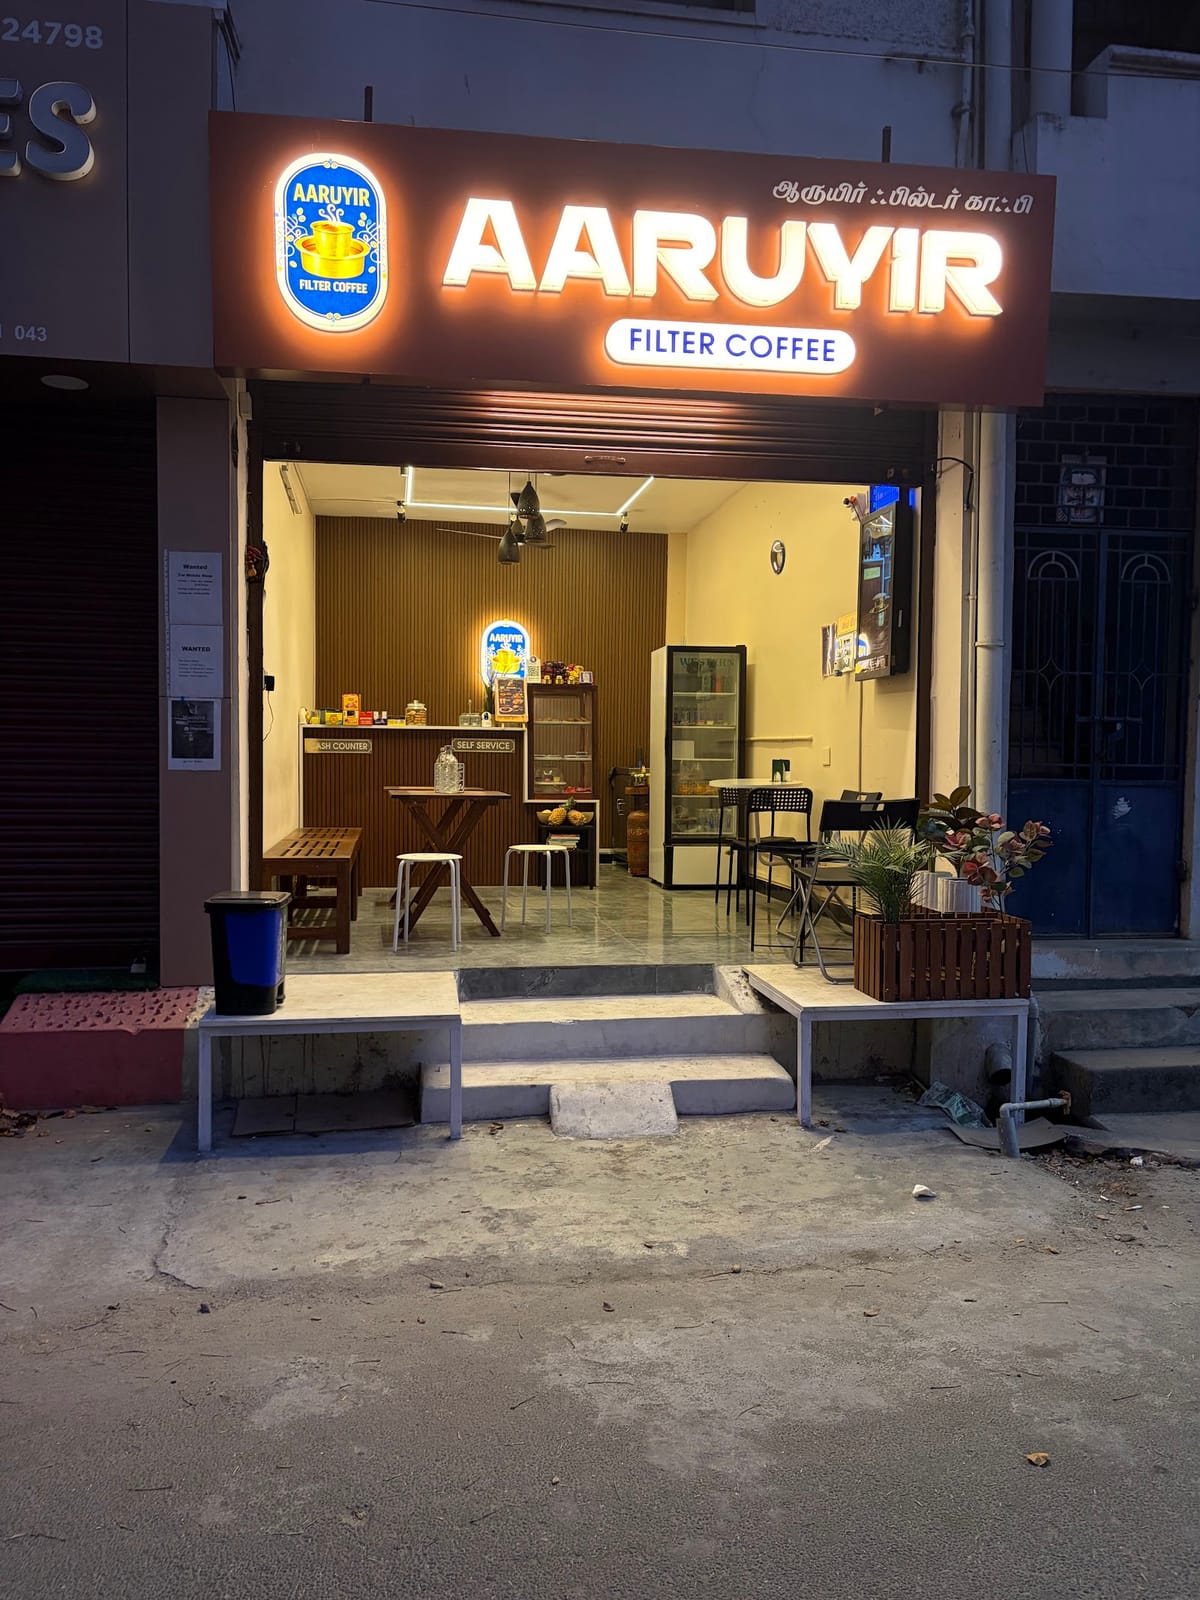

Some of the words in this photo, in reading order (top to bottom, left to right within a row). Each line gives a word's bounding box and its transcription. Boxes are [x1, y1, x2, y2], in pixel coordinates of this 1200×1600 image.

[2, 17, 103, 49] 24798
[293, 183, 370, 207] AARUYIR
[772, 181, 868, 205] ஆருயிர்
[870, 185, 962, 210] ஃபில்டர்
[964, 194, 1033, 214] காஃபி
[442, 197, 1004, 317] AARUYIR
[299, 279, 331, 292] FILTER
[333, 281, 368, 294] COFFEE
[15, 325, 47, 341] 043
[630, 328, 715, 355] FILTER
[726, 333, 835, 361] COFFEE
[313, 742, 331, 750] ASH
[332, 742, 368, 751] COUNTER
[456, 741, 475, 750] SELF
[476, 741, 510, 750] SERVICE
